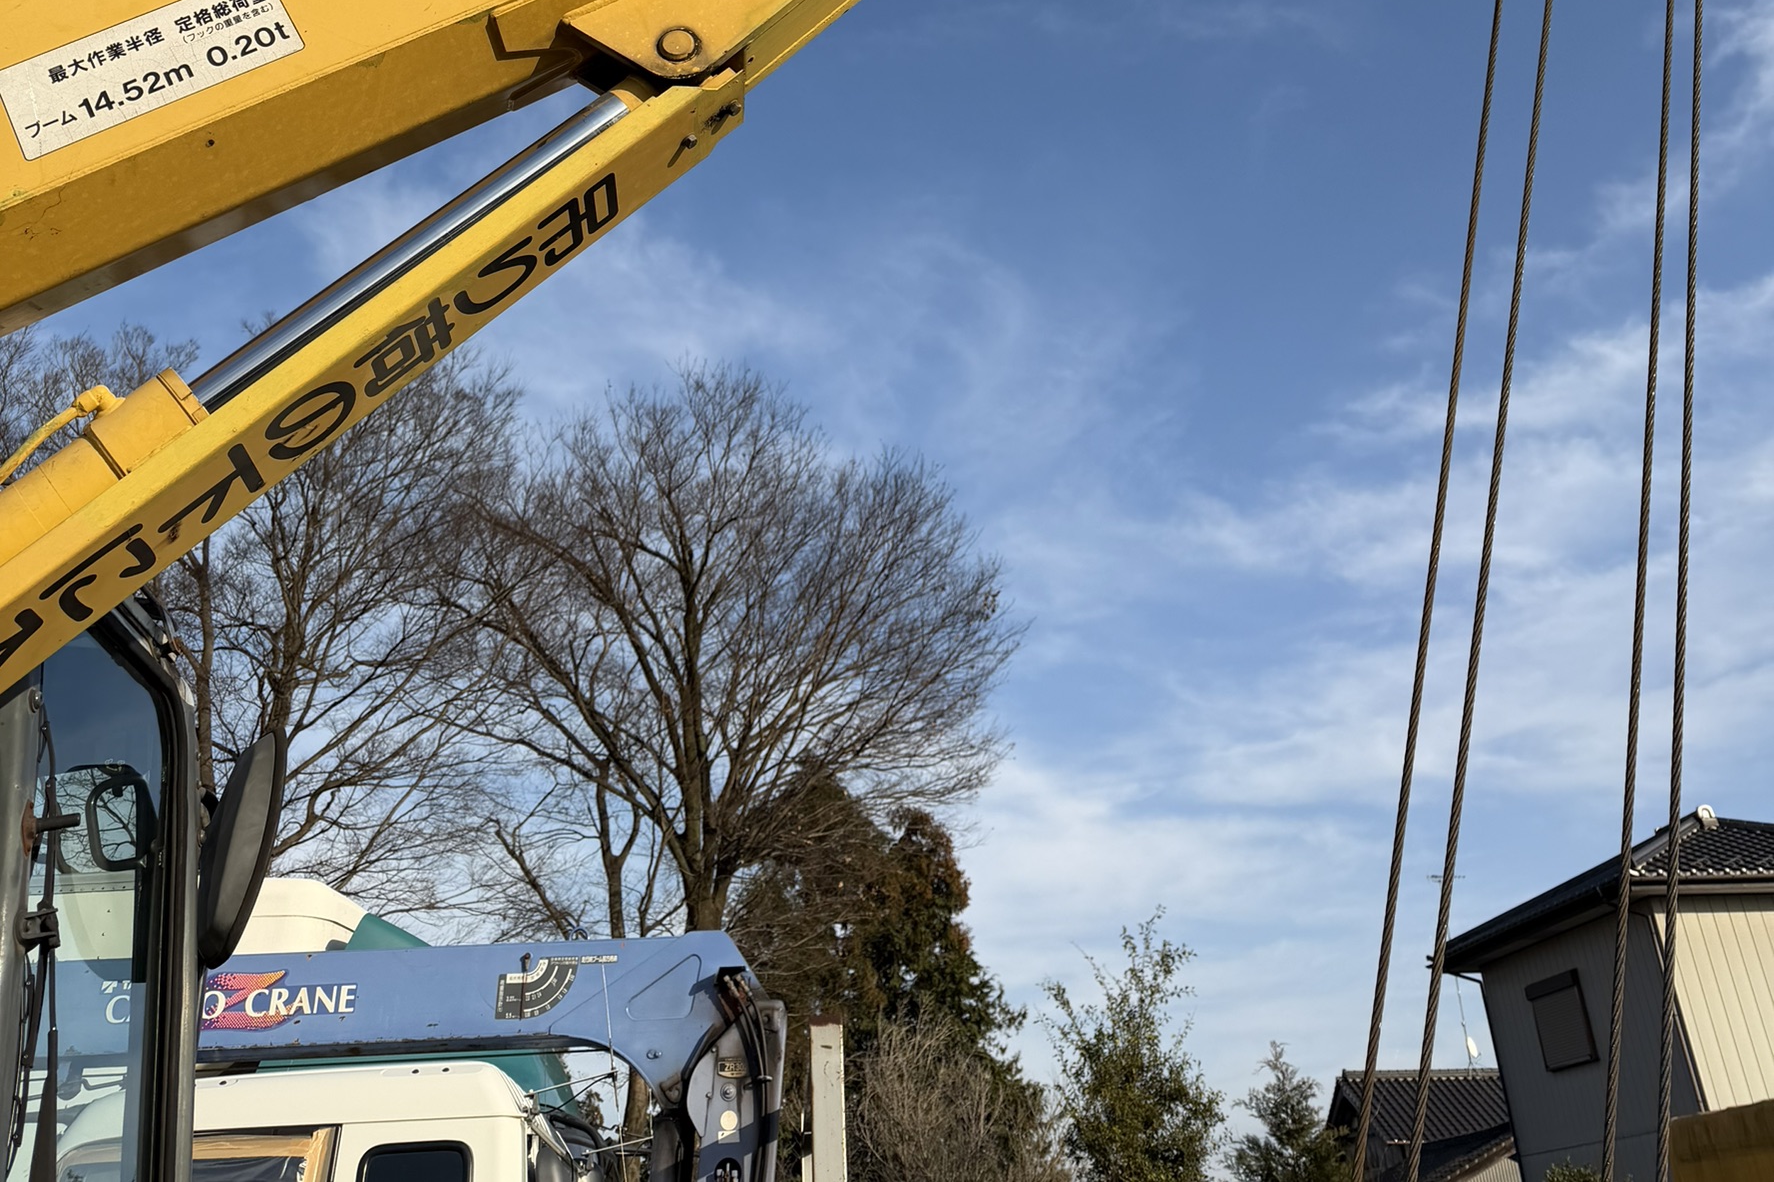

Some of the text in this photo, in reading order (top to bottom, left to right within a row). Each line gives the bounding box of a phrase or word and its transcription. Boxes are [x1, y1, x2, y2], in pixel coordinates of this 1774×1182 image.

[48, 27, 165, 84] 最大作業半径
[78, 63, 195, 119] 14.52m
[206, 21, 290, 67] 0.20t
[244, 984, 358, 1018] CRANE
